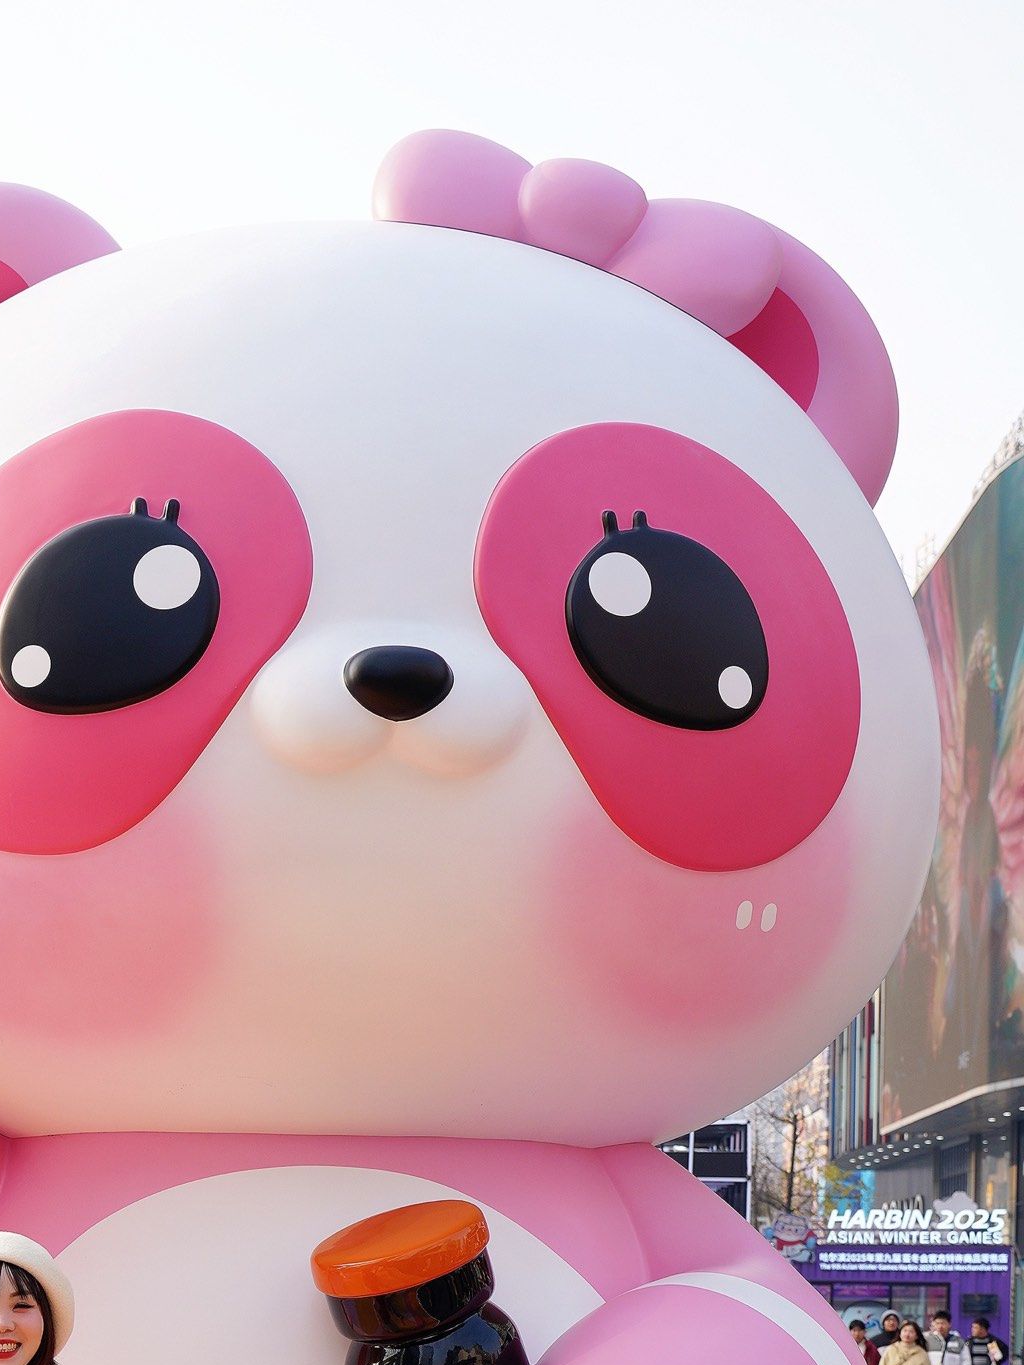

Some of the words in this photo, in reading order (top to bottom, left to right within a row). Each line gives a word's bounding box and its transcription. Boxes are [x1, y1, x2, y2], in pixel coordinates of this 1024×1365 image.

[827, 1208, 934, 1230] HARBIN
[935, 1208, 1008, 1233] 2025
[826, 1230, 875, 1245] ASIAN
[878, 1230, 942, 1245] WINTER
[946, 1230, 1004, 1245] GAMES
